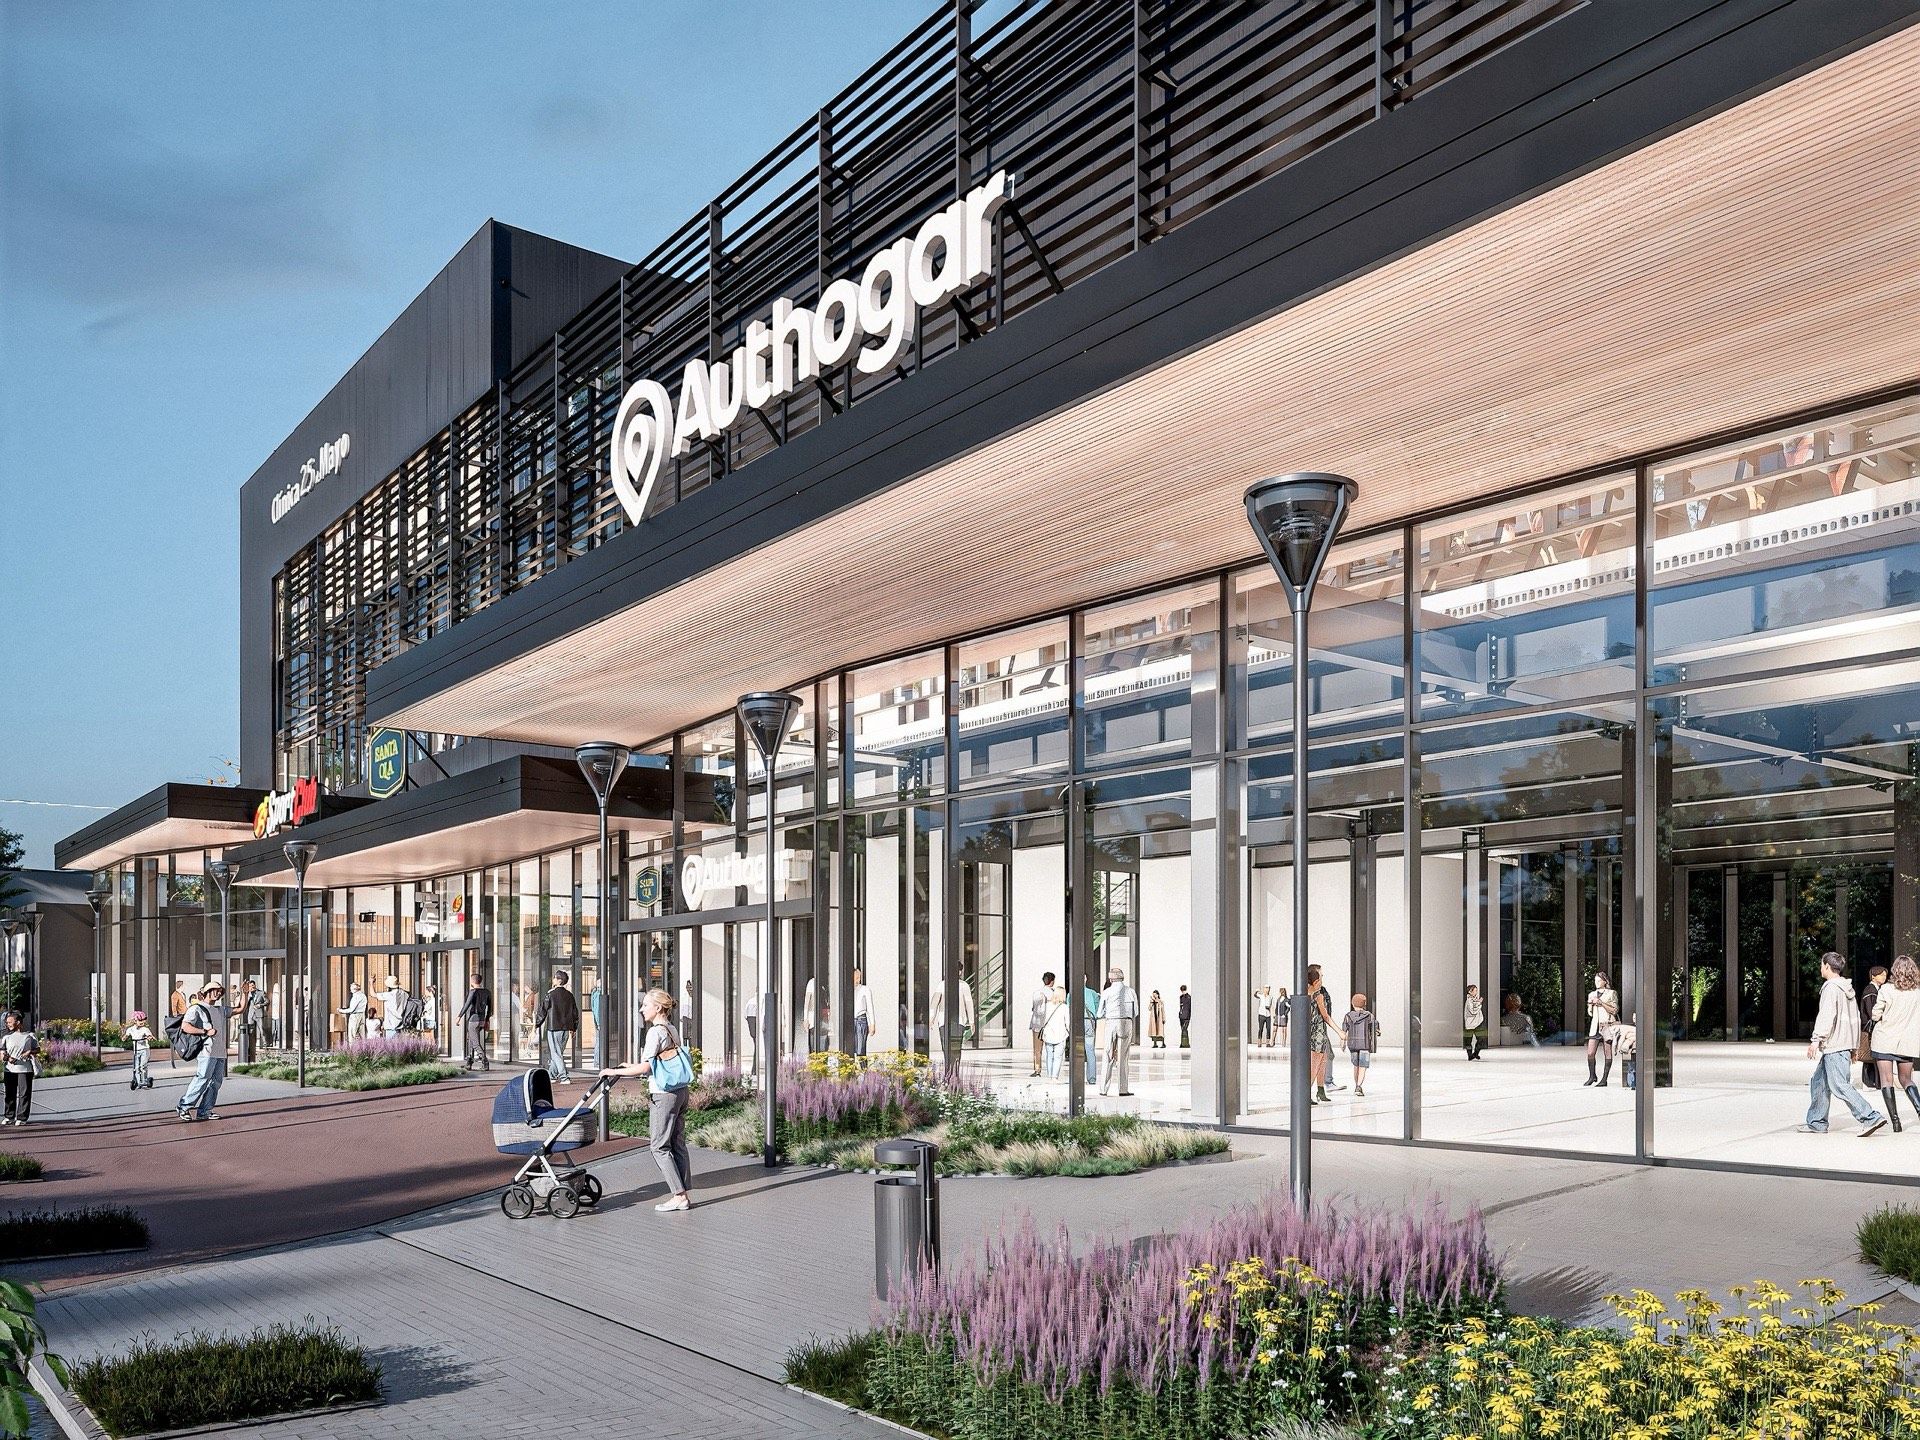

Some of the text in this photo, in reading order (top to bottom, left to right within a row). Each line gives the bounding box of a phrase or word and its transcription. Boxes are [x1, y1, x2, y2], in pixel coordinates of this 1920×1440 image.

[671, 169, 1013, 458] Authogar
[319, 433, 350, 480] Mayo
[374, 739, 399, 763] SANTA
